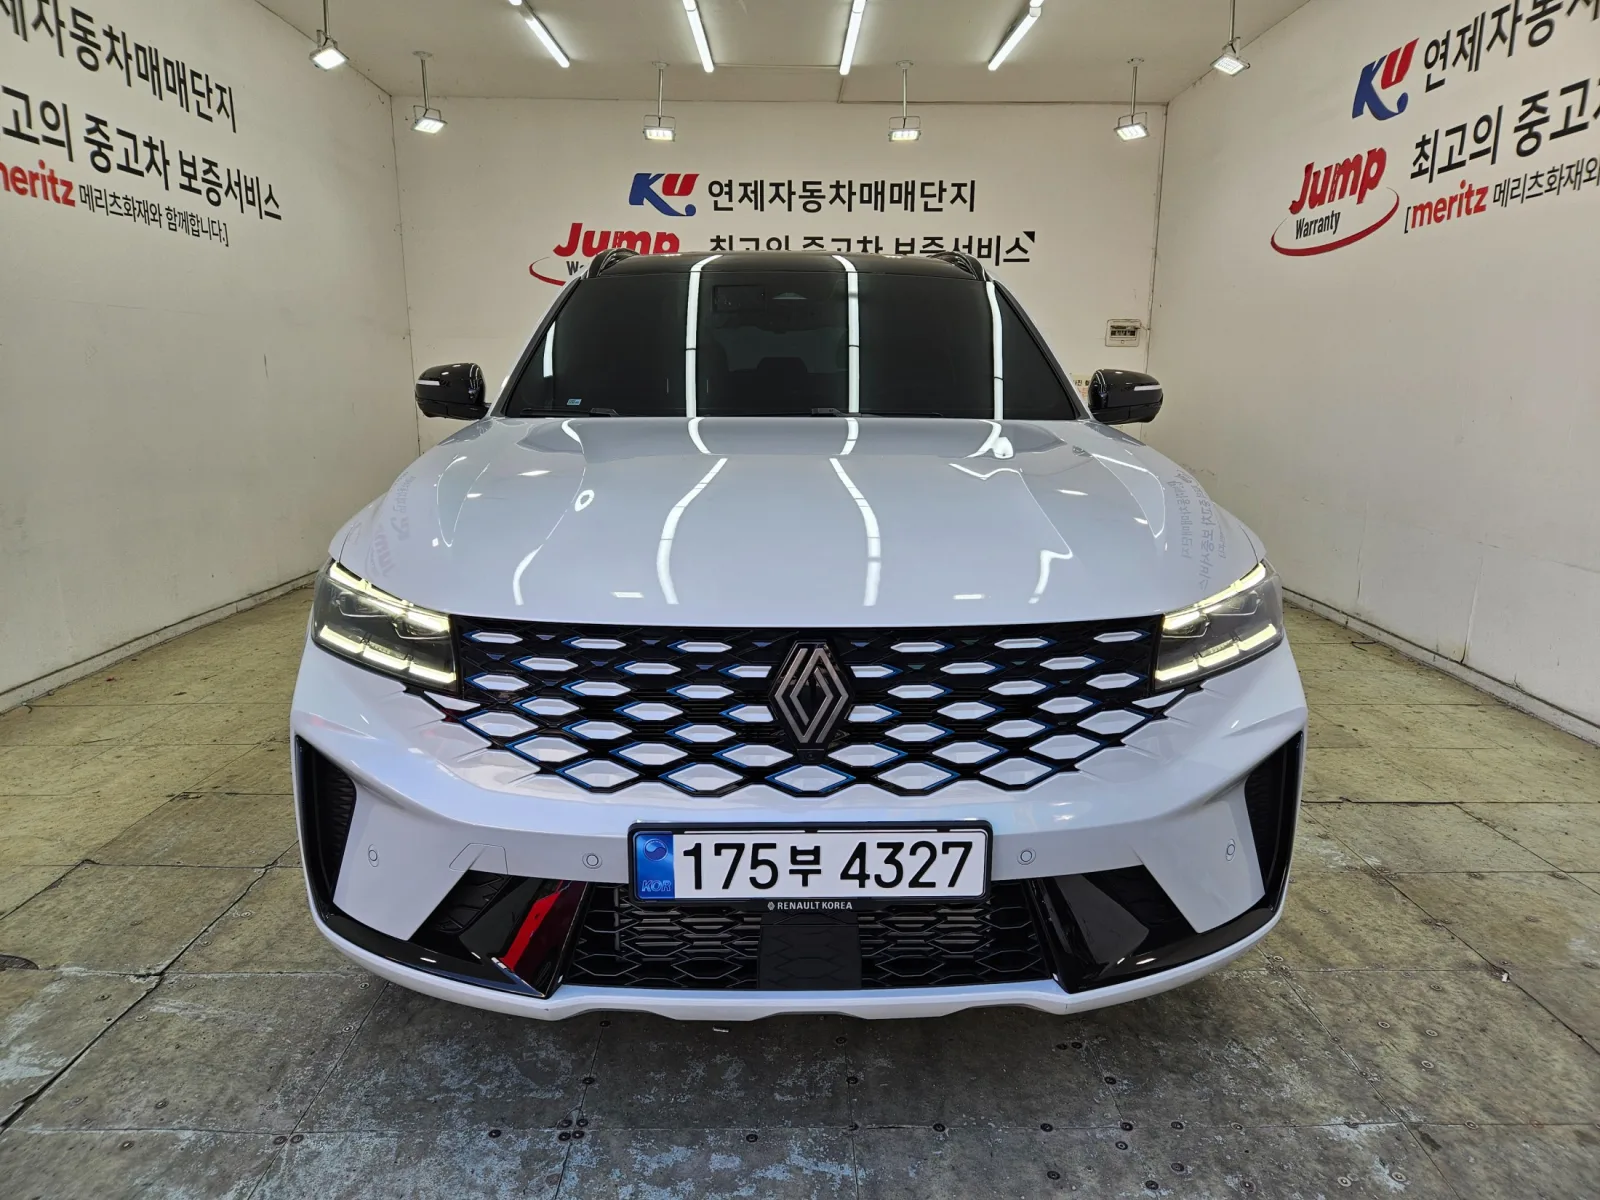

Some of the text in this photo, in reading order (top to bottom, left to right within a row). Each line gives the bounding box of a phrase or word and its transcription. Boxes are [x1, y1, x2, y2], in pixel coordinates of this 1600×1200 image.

[1410, 78, 1600, 184] 최고의 중고
[83, 113, 171, 191] 중고차
[179, 150, 282, 221] 보증서비스
[1289, 147, 1387, 215] Jump
[79, 184, 163, 229] 메리츠화재와
[708, 179, 976, 213] 연제자동차매매단지
[552, 222, 681, 258] Jump
[1295, 210, 1341, 240] Warranty
[683, 840, 973, 890] 175부 4327
[641, 879, 672, 892] KOR
[777, 901, 853, 910] RENAULT KOREA
